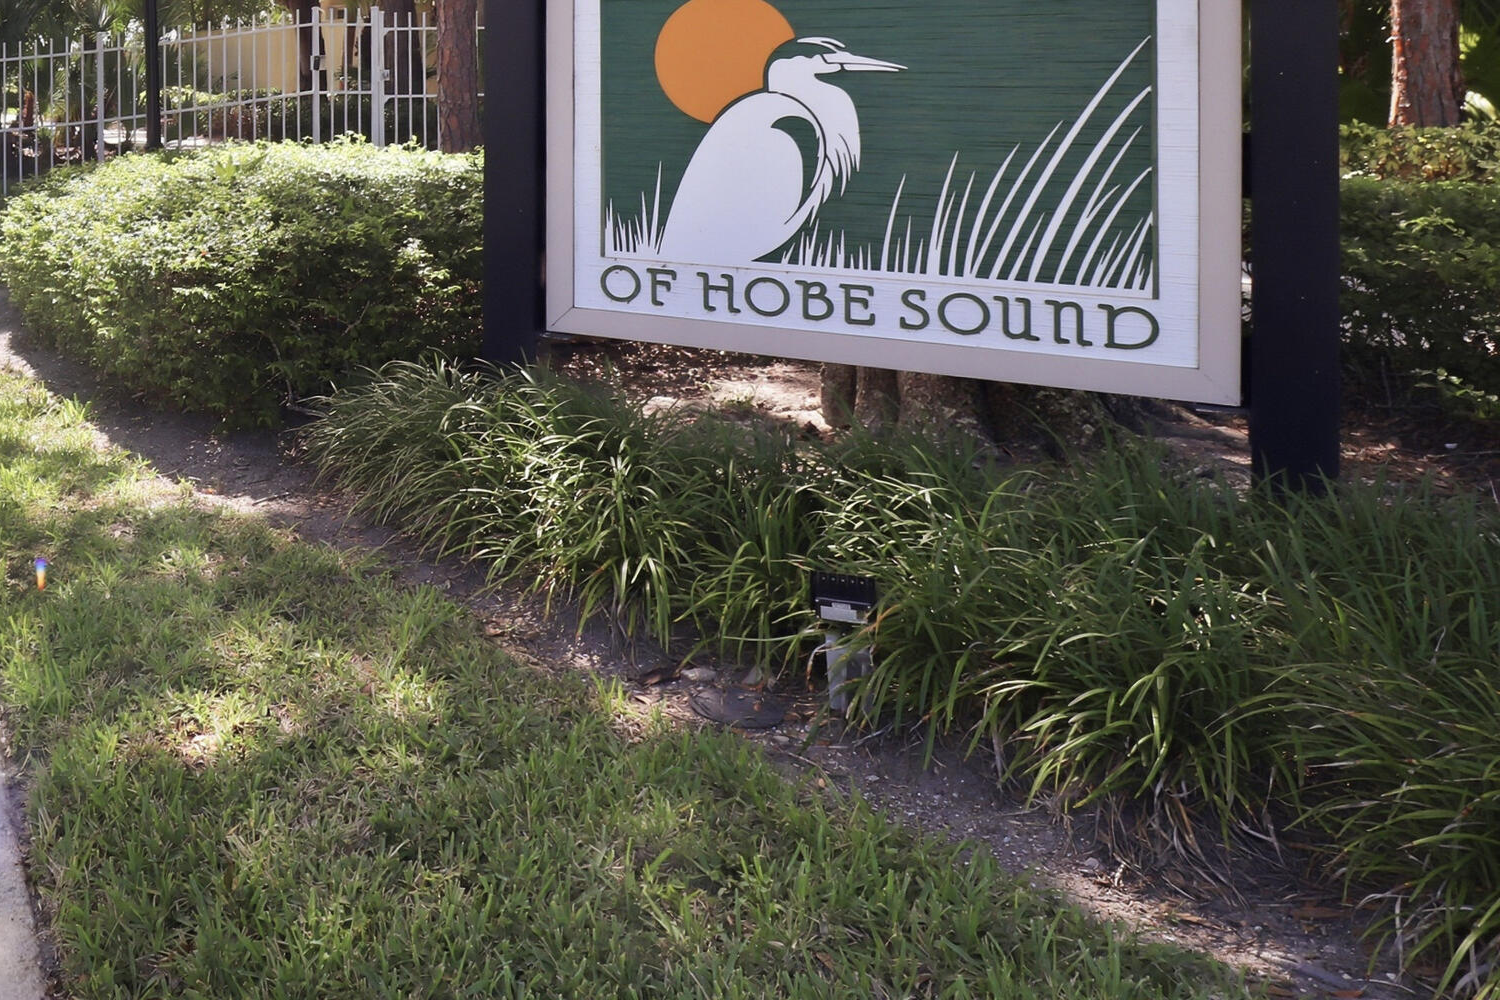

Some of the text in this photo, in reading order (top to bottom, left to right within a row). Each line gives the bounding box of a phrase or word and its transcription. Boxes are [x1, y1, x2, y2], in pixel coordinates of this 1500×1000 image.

[599, 264, 1161, 351] OF HOBE SOUND
